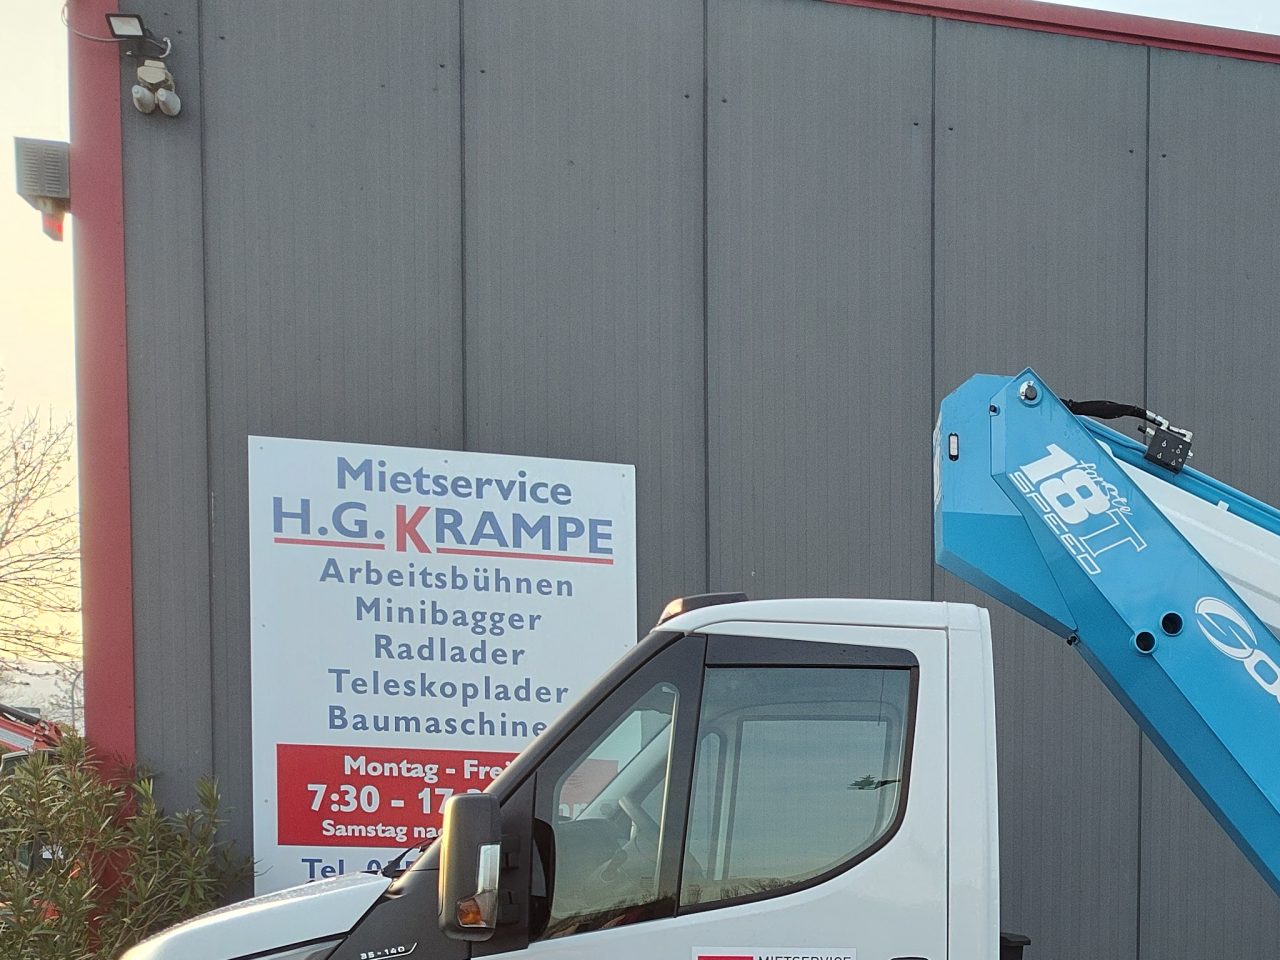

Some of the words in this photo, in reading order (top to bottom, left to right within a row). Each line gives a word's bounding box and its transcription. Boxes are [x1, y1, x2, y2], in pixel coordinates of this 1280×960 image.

[337, 456, 572, 505] Mietservice
[1009, 471, 1101, 574] SPEED
[320, 558, 573, 597] Arbeitsbühnen
[356, 597, 542, 636] Minibagger
[374, 634, 526, 665] Radlader
[328, 668, 569, 707] Teleskoplader
[344, 755, 439, 783] Montag
[307, 783, 380, 813] 7:30
[391, 799, 405, 808] -
[322, 819, 408, 842] Samstag
